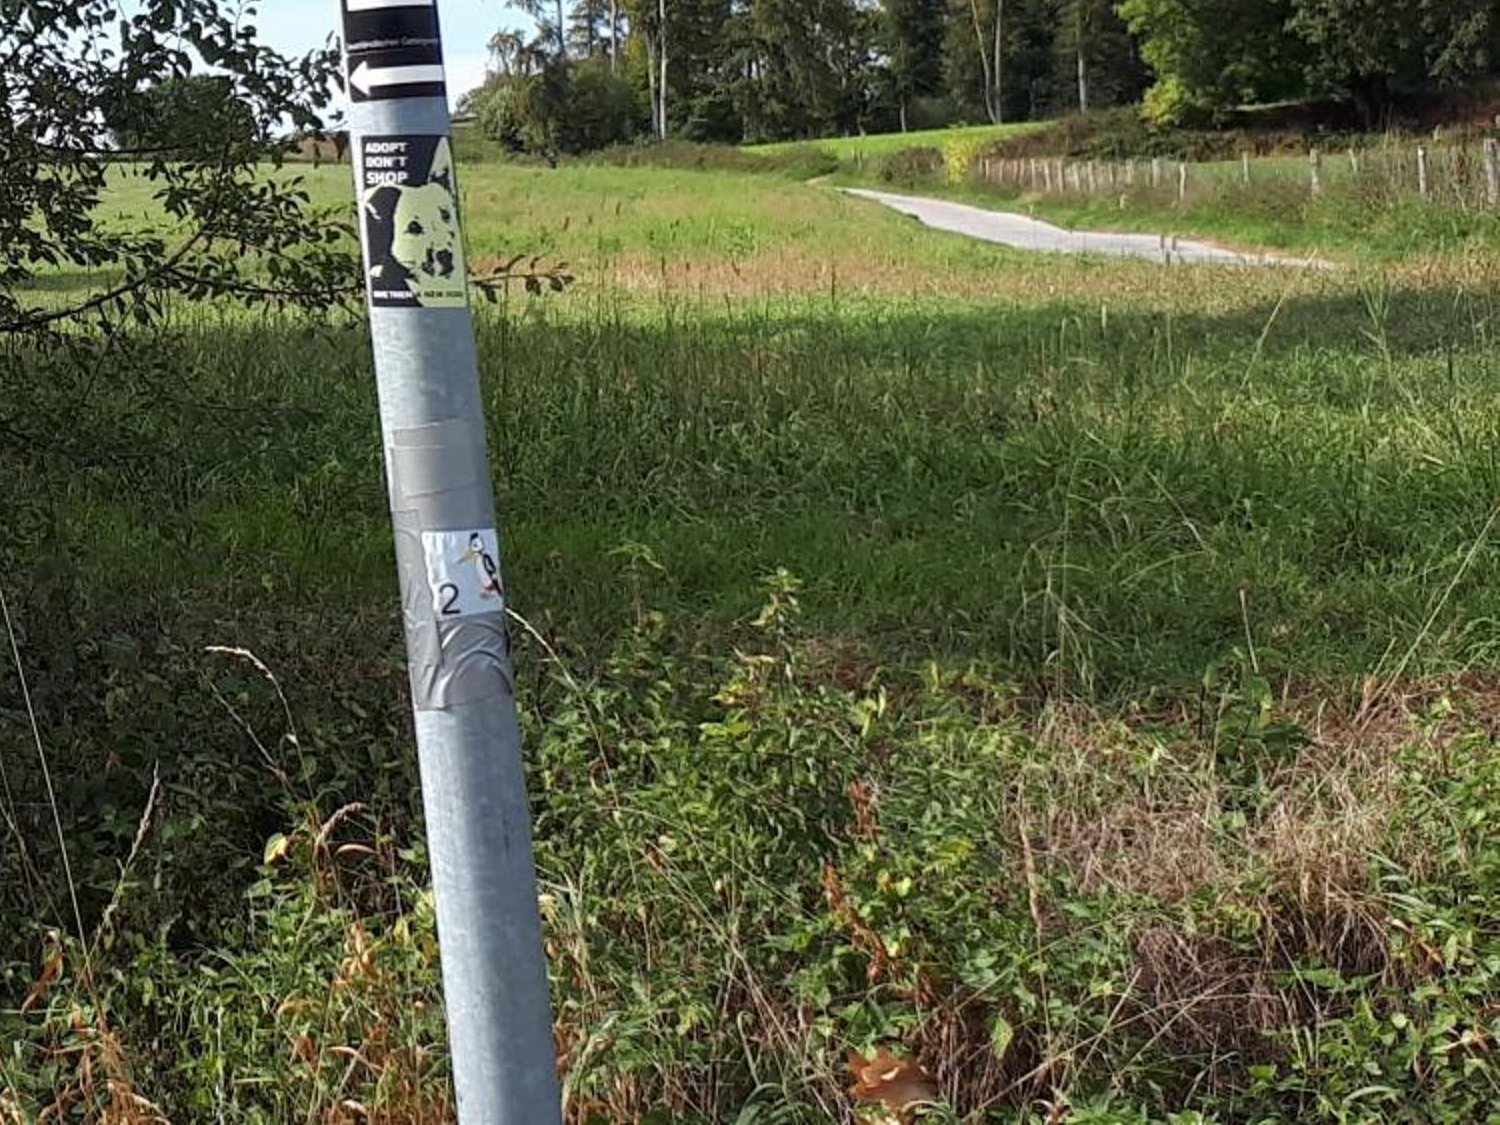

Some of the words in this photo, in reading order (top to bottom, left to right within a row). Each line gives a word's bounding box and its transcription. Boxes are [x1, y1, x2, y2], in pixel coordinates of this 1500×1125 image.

[365, 142, 408, 153] ADOPT
[366, 171, 407, 184] SHOP
[438, 582, 461, 615] 2
